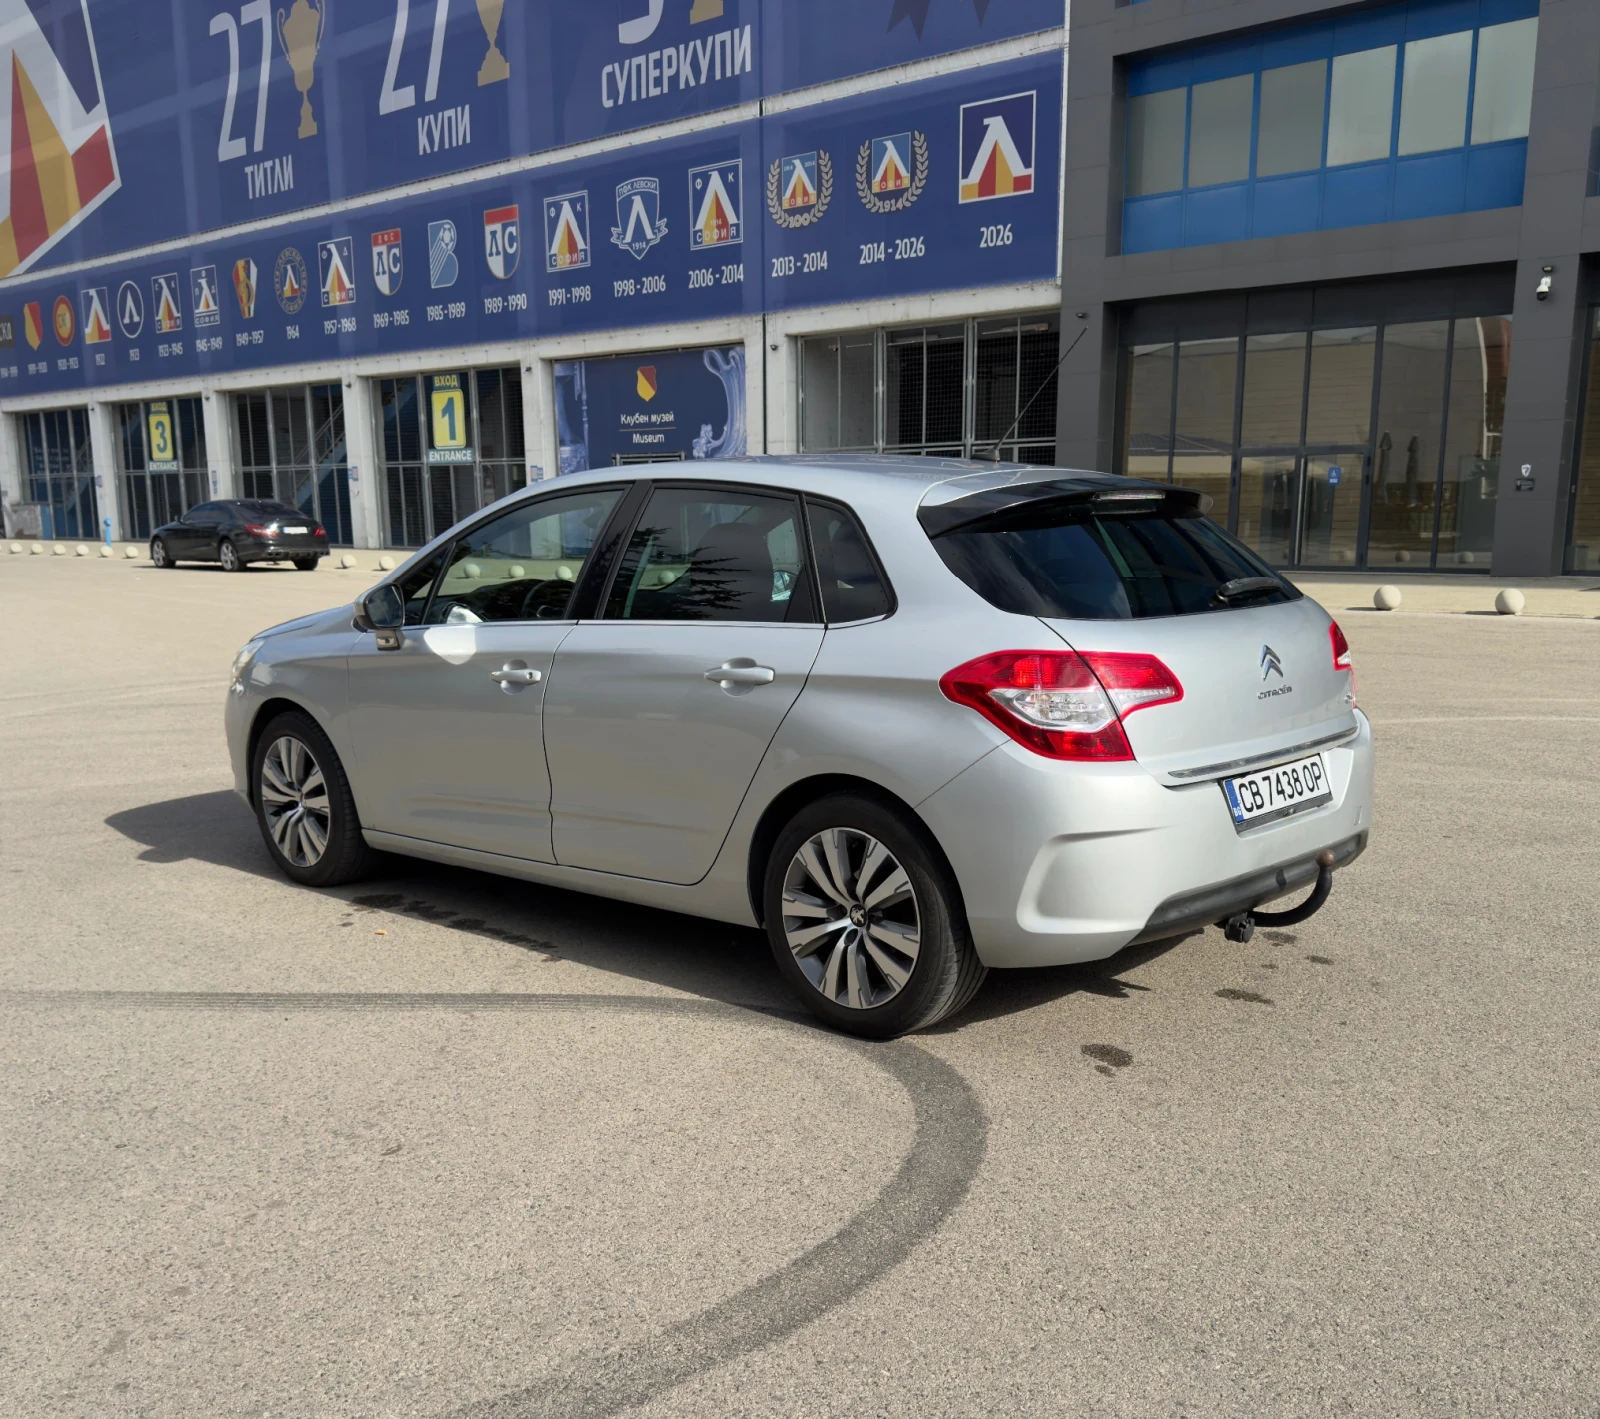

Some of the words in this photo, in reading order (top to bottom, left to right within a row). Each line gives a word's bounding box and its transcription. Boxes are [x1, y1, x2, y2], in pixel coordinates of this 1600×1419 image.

[601, 24, 752, 109] СУПЕРКУПИ
[209, 0, 272, 162] 27
[417, 104, 471, 156] КУПИ
[244, 154, 294, 200] ТИТЛИ
[618, 183, 632, 196] ПФК
[633, 180, 656, 190] ЛЕВСКИ
[878, 198, 904, 213] 1914
[788, 213, 810, 228] 100
[696, 226, 737, 242] СОФИЯ
[979, 223, 1013, 248] 2026
[632, 241, 647, 250] 1914
[859, 241, 885, 265] 2014
[894, 236, 925, 260] 2026
[551, 251, 585, 265] СОФИЯ
[771, 256, 795, 277] 2013
[803, 250, 828, 273] 2014
[688, 268, 714, 289] 2006
[721, 263, 744, 284] 2014
[548, 288, 566, 306] 1991
[571, 285, 592, 303] 1998
[613, 279, 635, 298] 1998
[641, 275, 666, 294] 2006
[426, 305, 444, 321] 1985
[448, 302, 466, 319] 1989
[484, 297, 503, 314] 1989
[508, 293, 527, 311] 1990
[373, 312, 389, 328] 1969
[393, 310, 410, 326] 1985
[434, 374, 458, 387] ВХОД
[441, 397, 457, 441] 1
[620, 412, 649, 427] Клубен
[650, 411, 675, 425] музей
[155, 420, 168, 453] 3
[632, 432, 665, 444] Museum
[149, 461, 178, 470] ENTRANCE
[428, 450, 472, 462] ENTRANCE
[1261, 768, 1304, 806] 7438
[1233, 806, 1242, 817] BG
